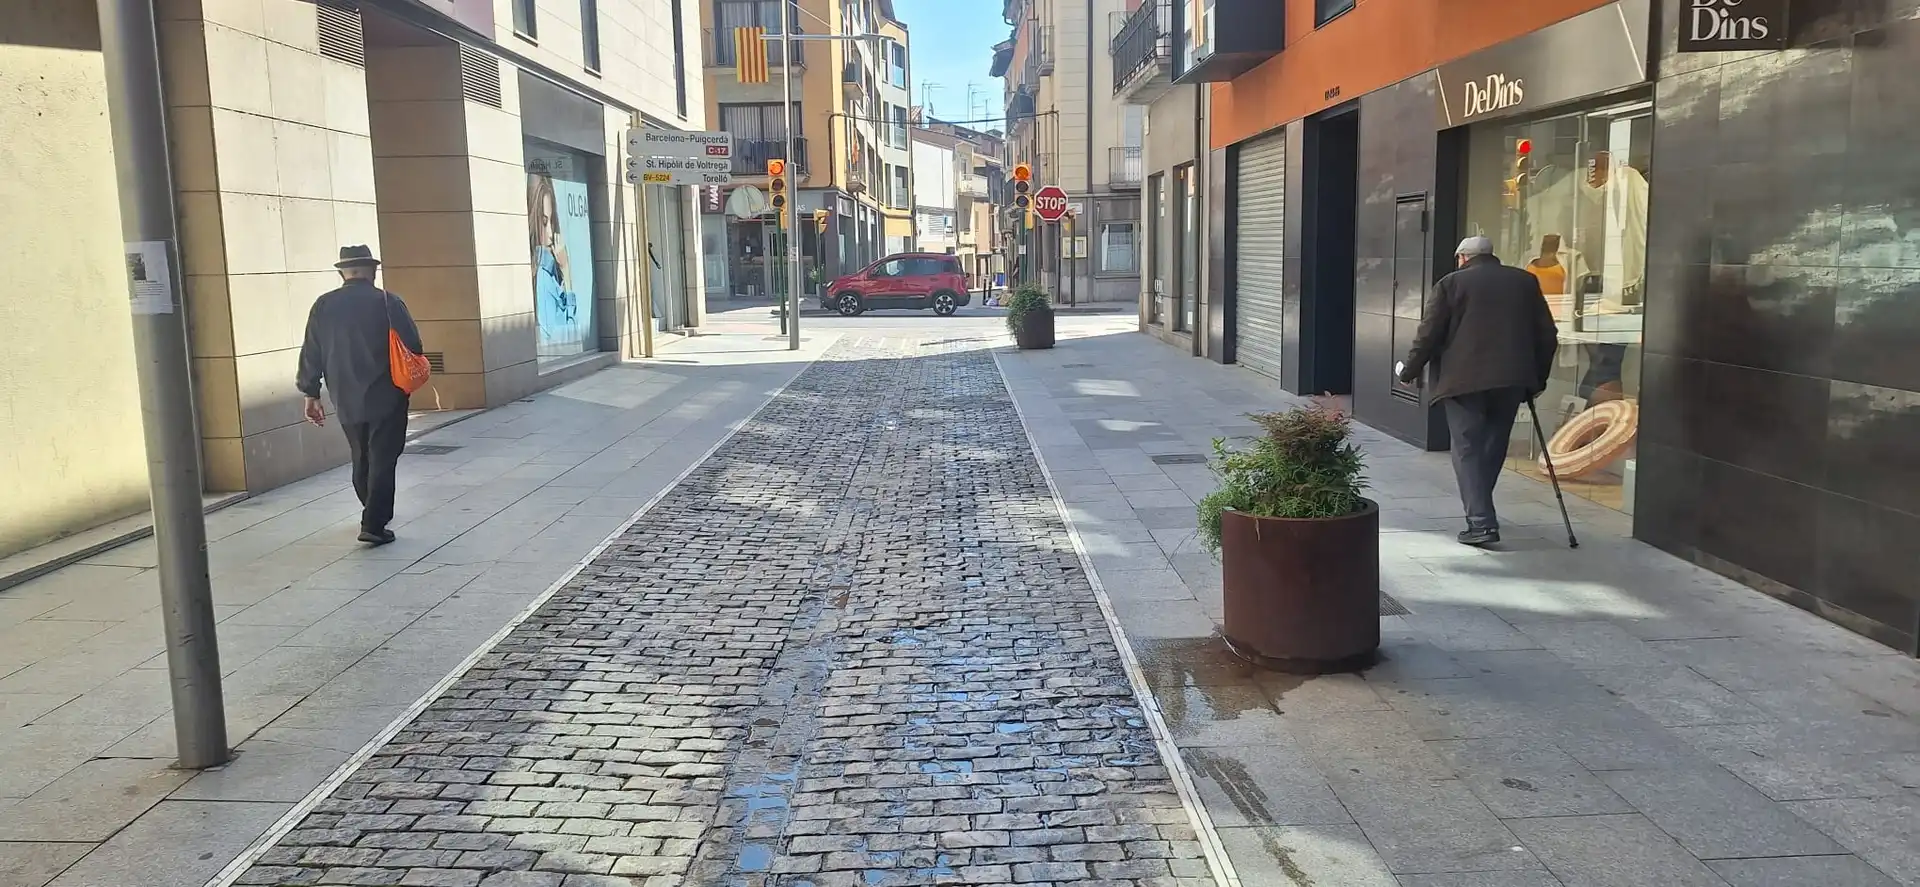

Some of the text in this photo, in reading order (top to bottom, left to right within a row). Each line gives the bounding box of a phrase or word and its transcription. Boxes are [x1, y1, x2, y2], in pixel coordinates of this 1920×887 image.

[1690, 7, 1768, 41] Dins
[1464, 73, 1523, 118] DeDins
[645, 133, 729, 144] Barcelona-Puigcerdà
[646, 160, 728, 170] St. Hipòlit de Voltregà
[643, 173, 728, 183] BV-5224 Torelló
[567, 192, 589, 217] OLGA
[1036, 197, 1066, 210] STOP
